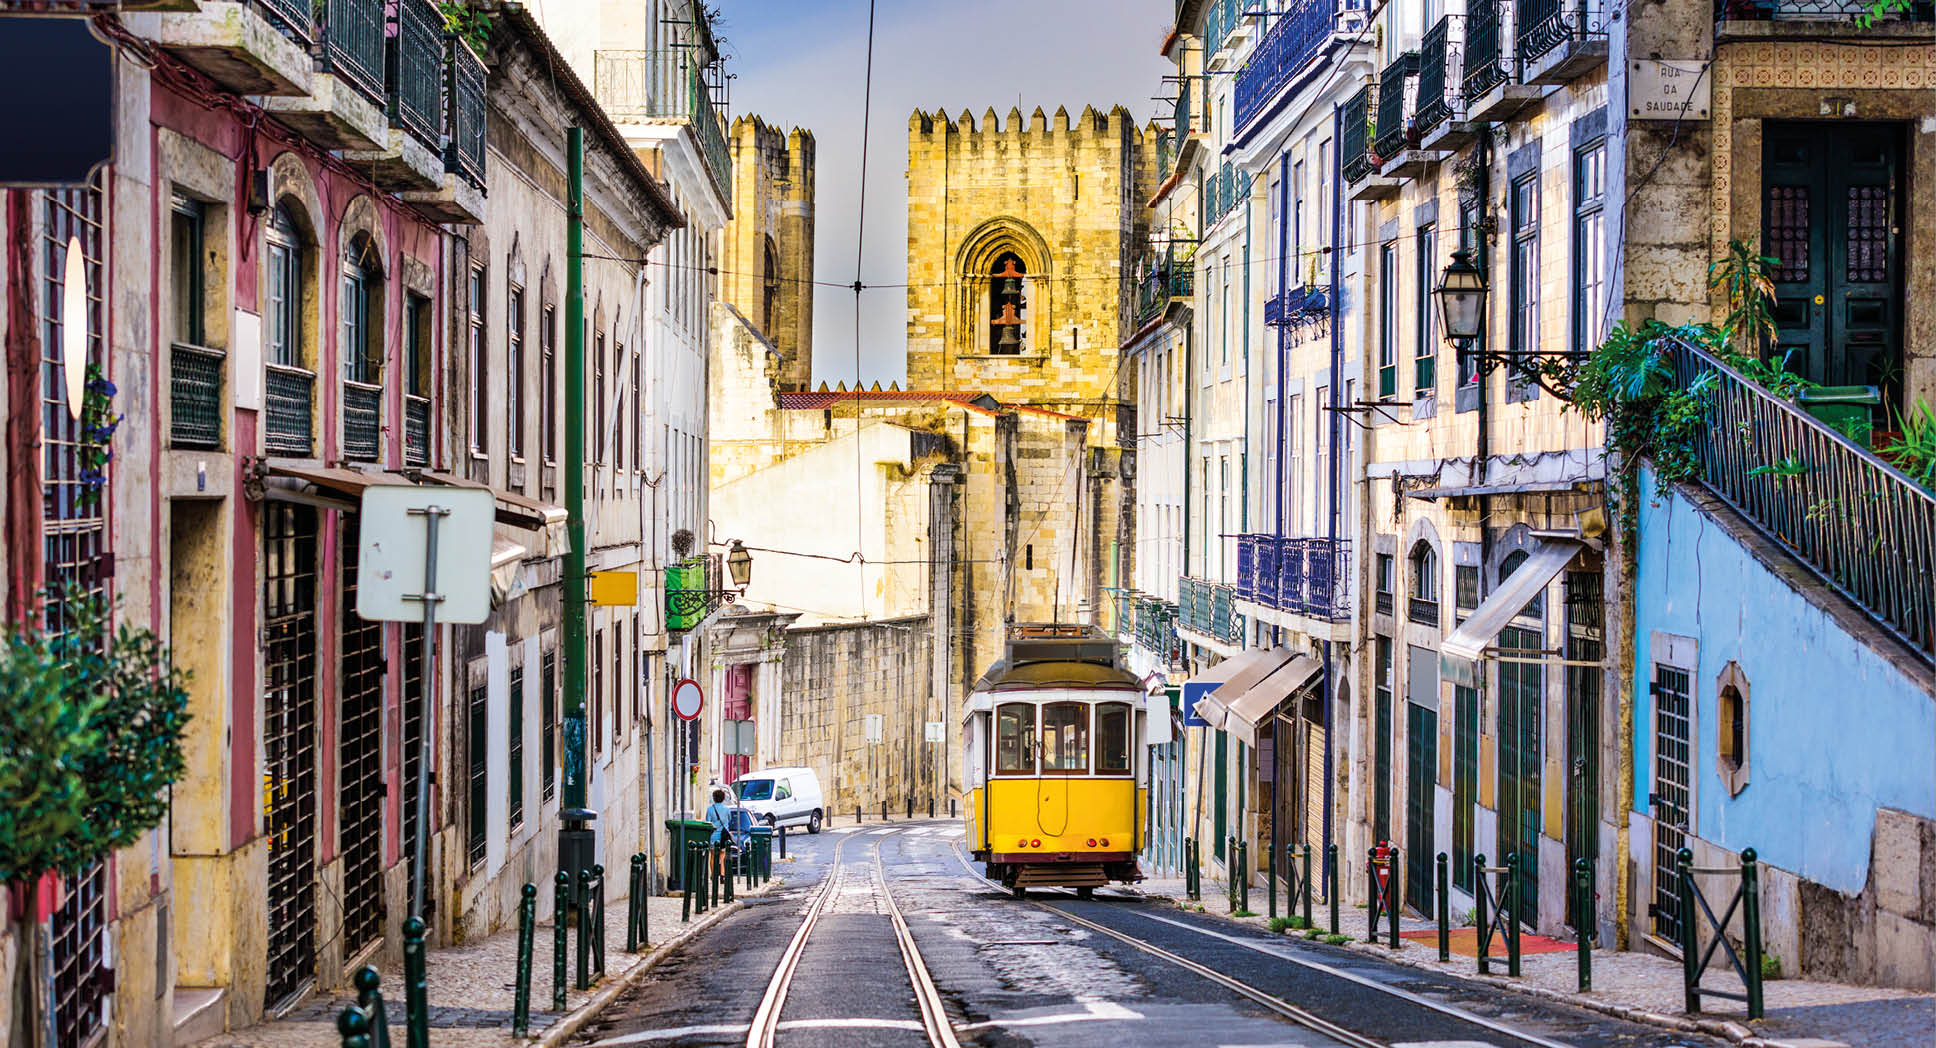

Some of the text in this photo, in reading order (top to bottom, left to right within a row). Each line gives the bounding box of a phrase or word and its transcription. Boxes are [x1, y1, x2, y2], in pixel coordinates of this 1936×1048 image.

[1661, 67, 1681, 78] RUA
[1663, 84, 1677, 95] DA
[1646, 101, 1694, 112] SAUDADE
